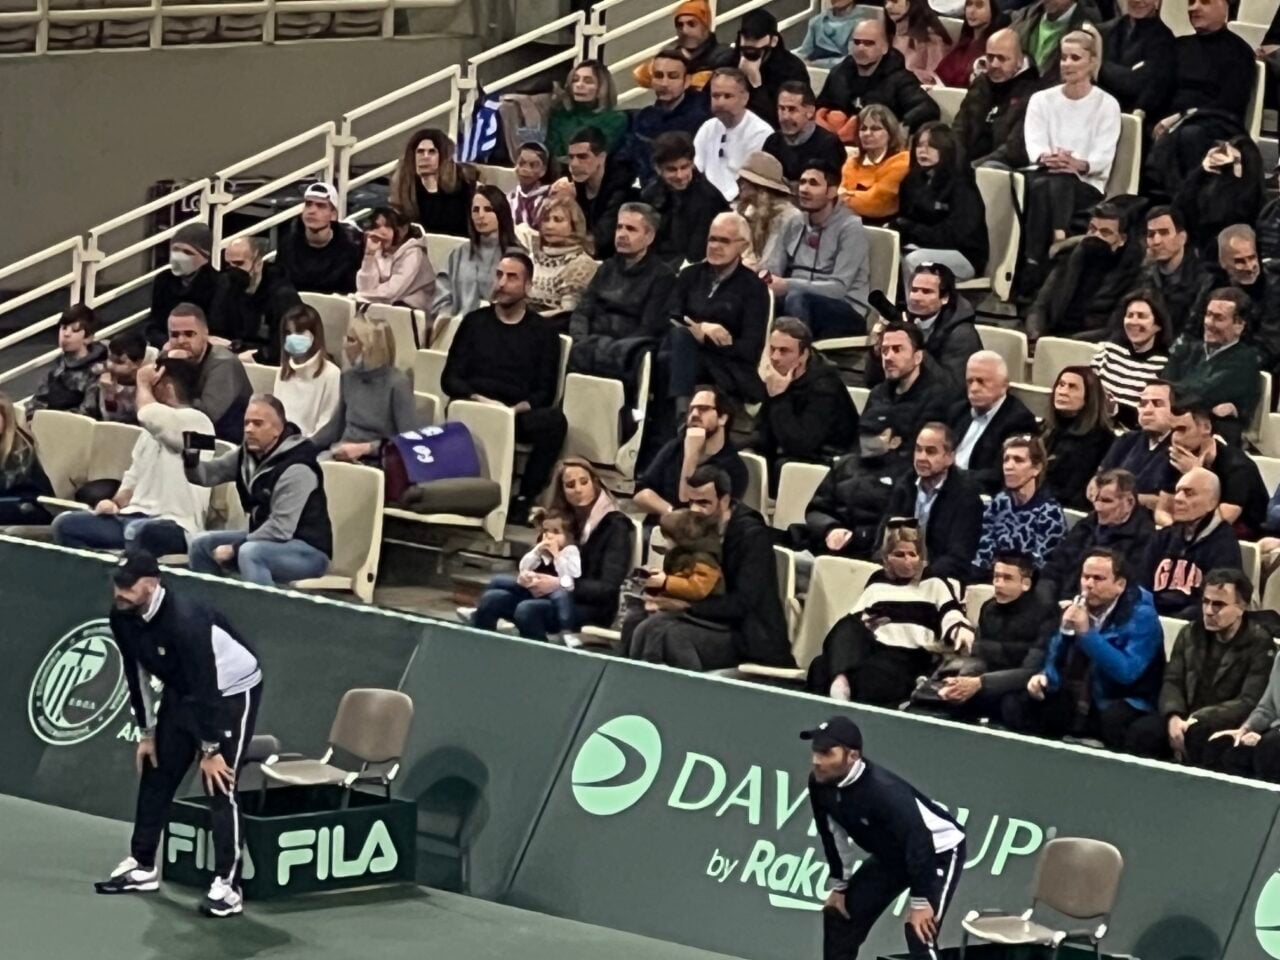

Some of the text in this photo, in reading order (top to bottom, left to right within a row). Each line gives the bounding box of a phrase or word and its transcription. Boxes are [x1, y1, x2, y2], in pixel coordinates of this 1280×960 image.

[667, 751, 1043, 876] DAV UP
[277, 819, 399, 886] FILA
[706, 848, 739, 883] by
